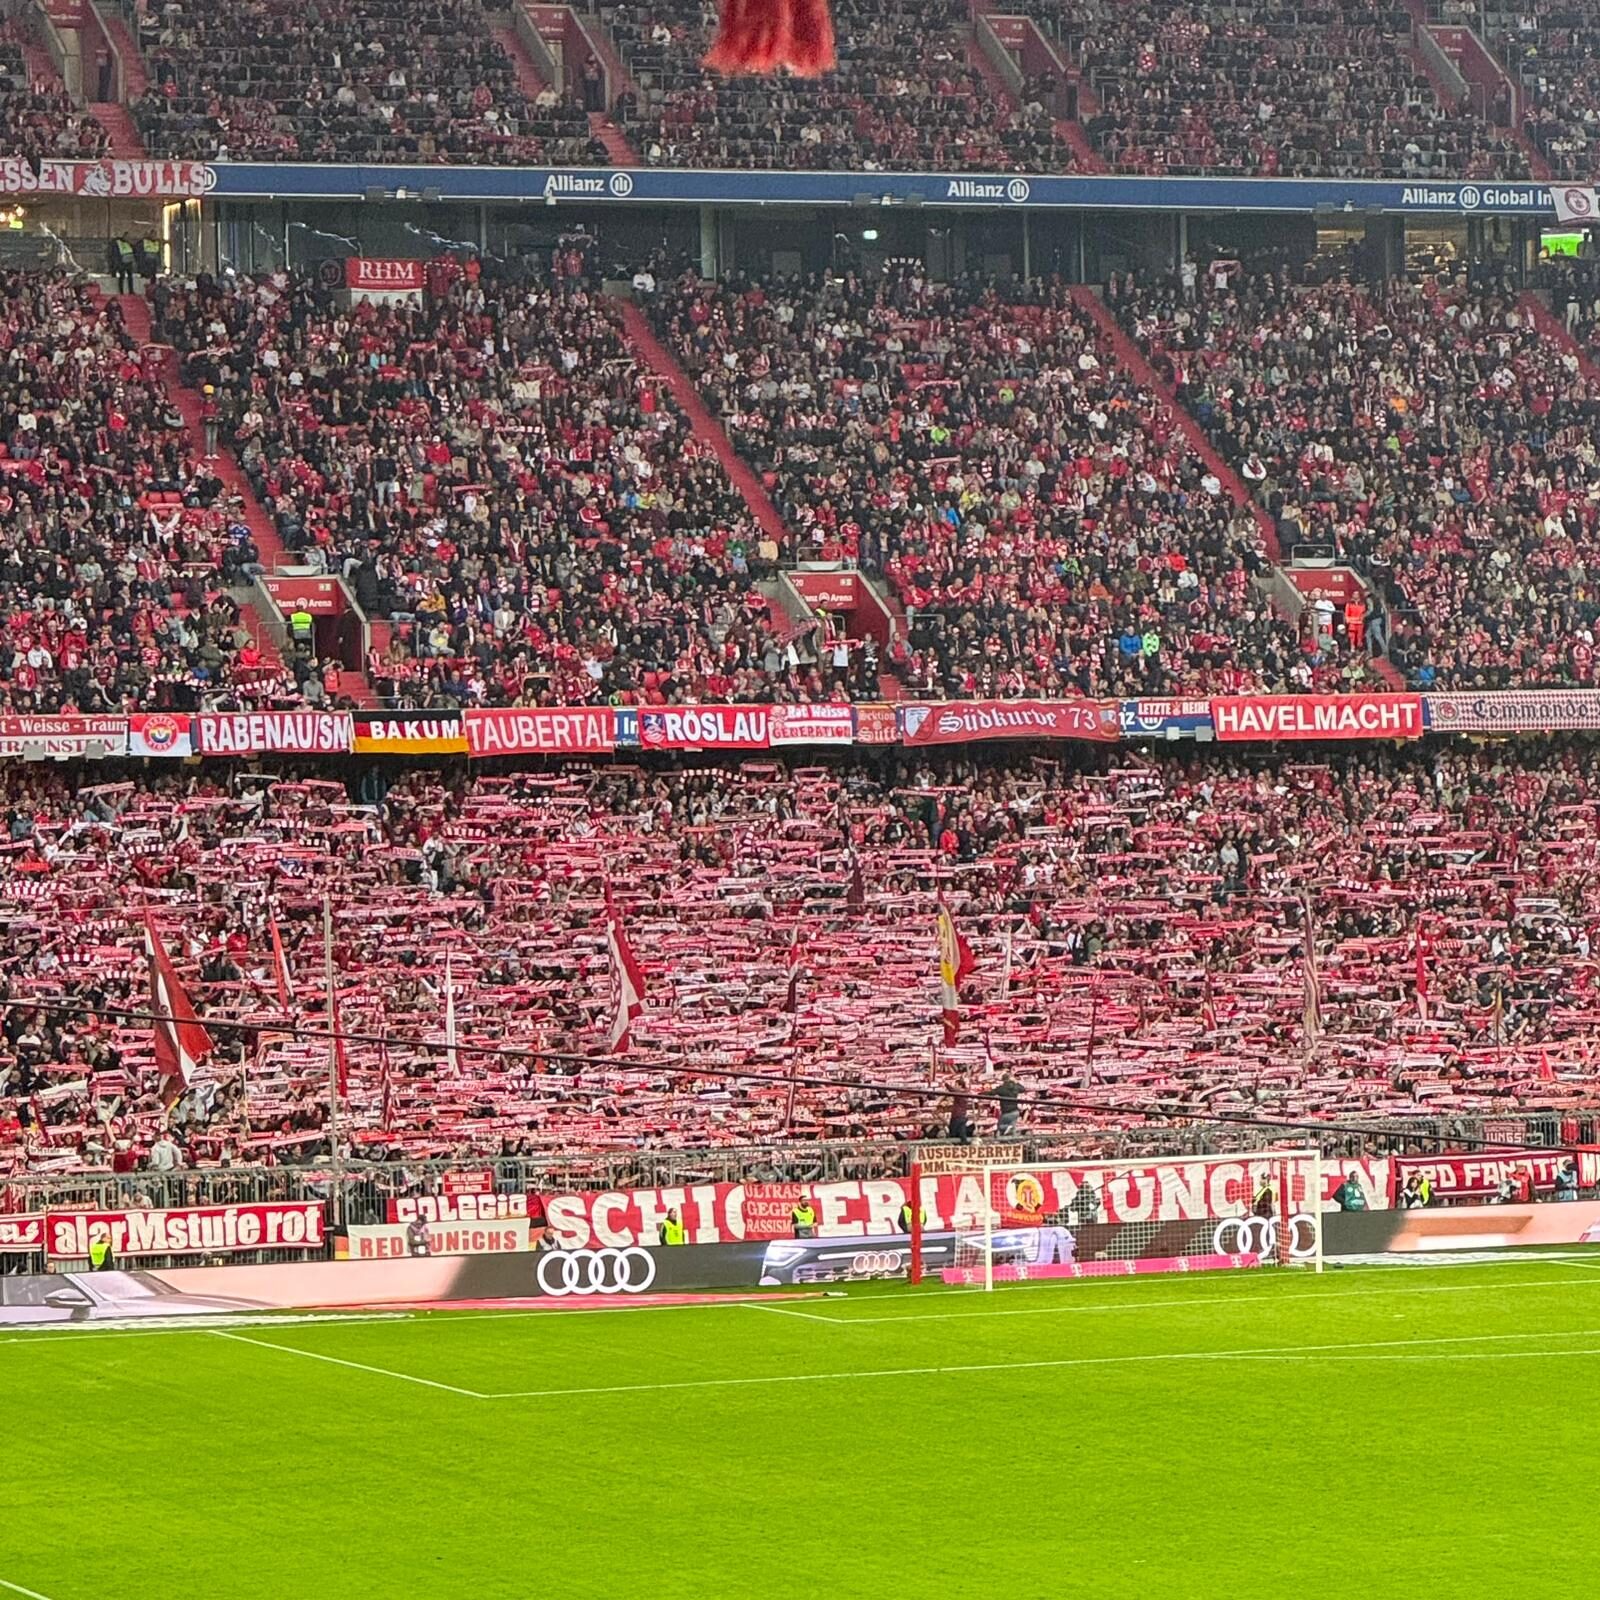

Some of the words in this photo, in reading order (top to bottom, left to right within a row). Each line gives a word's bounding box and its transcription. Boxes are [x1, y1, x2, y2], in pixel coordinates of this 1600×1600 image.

[0, 159, 75, 192] SSEN
[112, 160, 205, 195] BULLS
[546, 174, 604, 192] Allianz
[947, 181, 1004, 197] Allianz
[1401, 188, 1456, 204] Allianz
[1483, 189, 1533, 205] Global
[358, 261, 415, 279] RHM
[1138, 703, 1171, 715] LETZTE
[1182, 702, 1210, 714] REIHE
[1219, 703, 1417, 732] HAVELMACHT
[1473, 699, 1588, 719] Commando
[20, 719, 70, 733] Weisse
[370, 719, 460, 740] BAKUM
[665, 710, 766, 742] RÖSLAU
[939, 707, 1056, 734] Südkurve
[467, 714, 614, 751] TAUBERTAL
[917, 1146, 1021, 1160] AUSGESPERRTE
[745, 1184, 801, 1199] ULTRAS
[54, 1209, 261, 1255] alarMstufe
[266, 1206, 321, 1244] rot
[746, 1219, 796, 1234] RASSISM
[360, 1236, 404, 1258] RED
